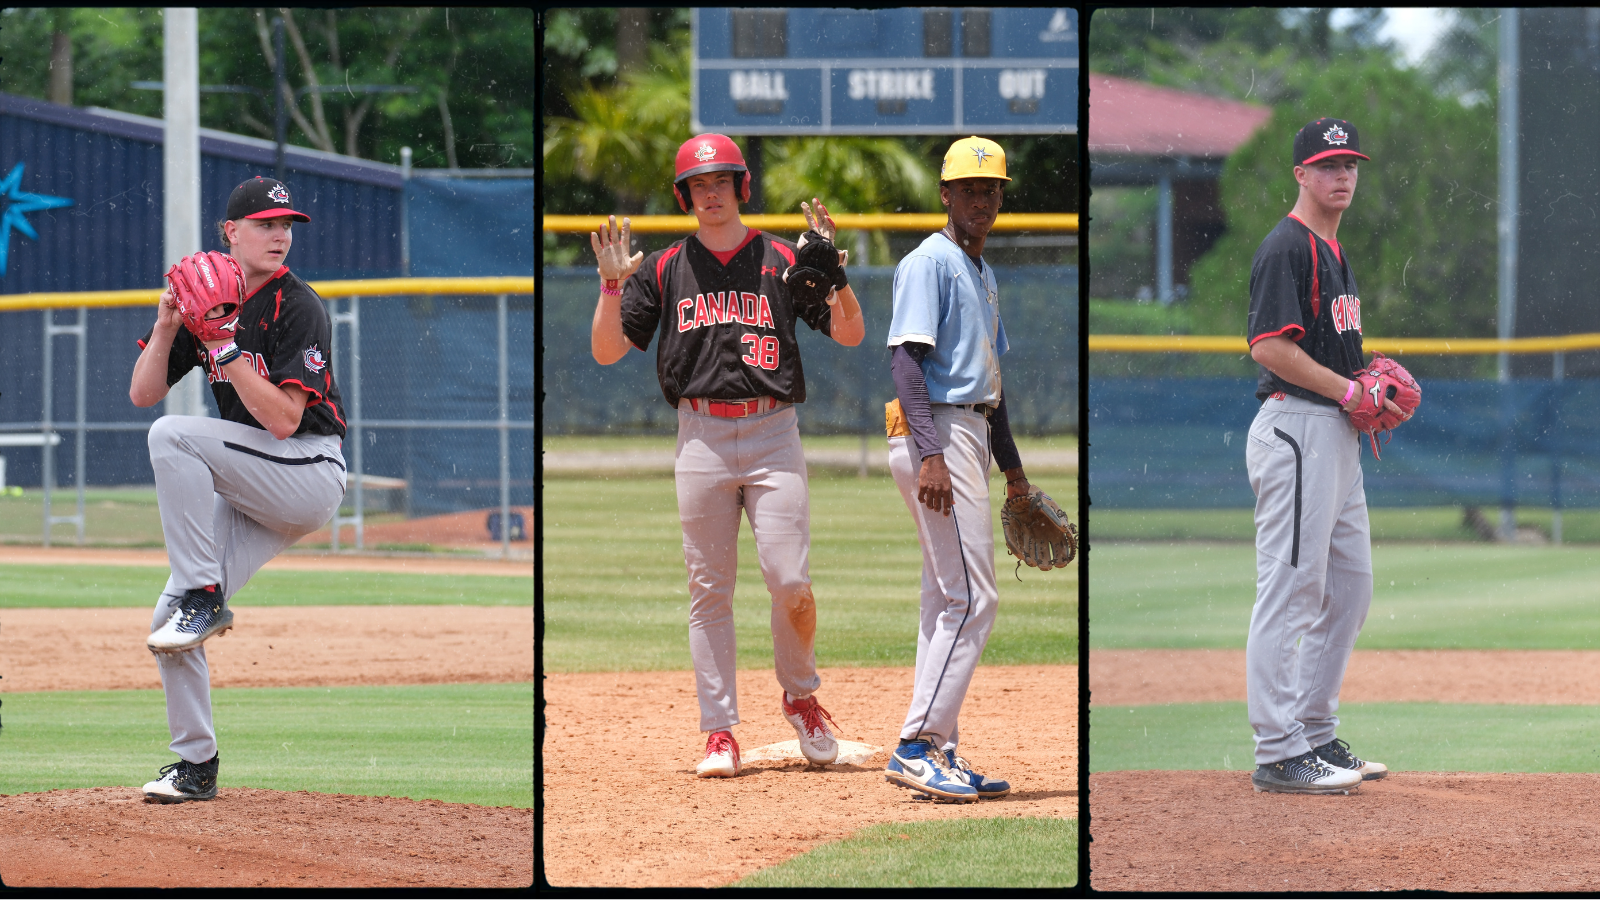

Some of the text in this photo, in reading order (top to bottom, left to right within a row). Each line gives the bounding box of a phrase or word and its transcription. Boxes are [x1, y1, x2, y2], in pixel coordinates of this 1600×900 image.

[730, 70, 788, 100] BALL
[849, 70, 935, 101] STRIKE
[999, 69, 1046, 100] OUT
[677, 291, 776, 333] CANADA
[741, 333, 780, 371] 38
